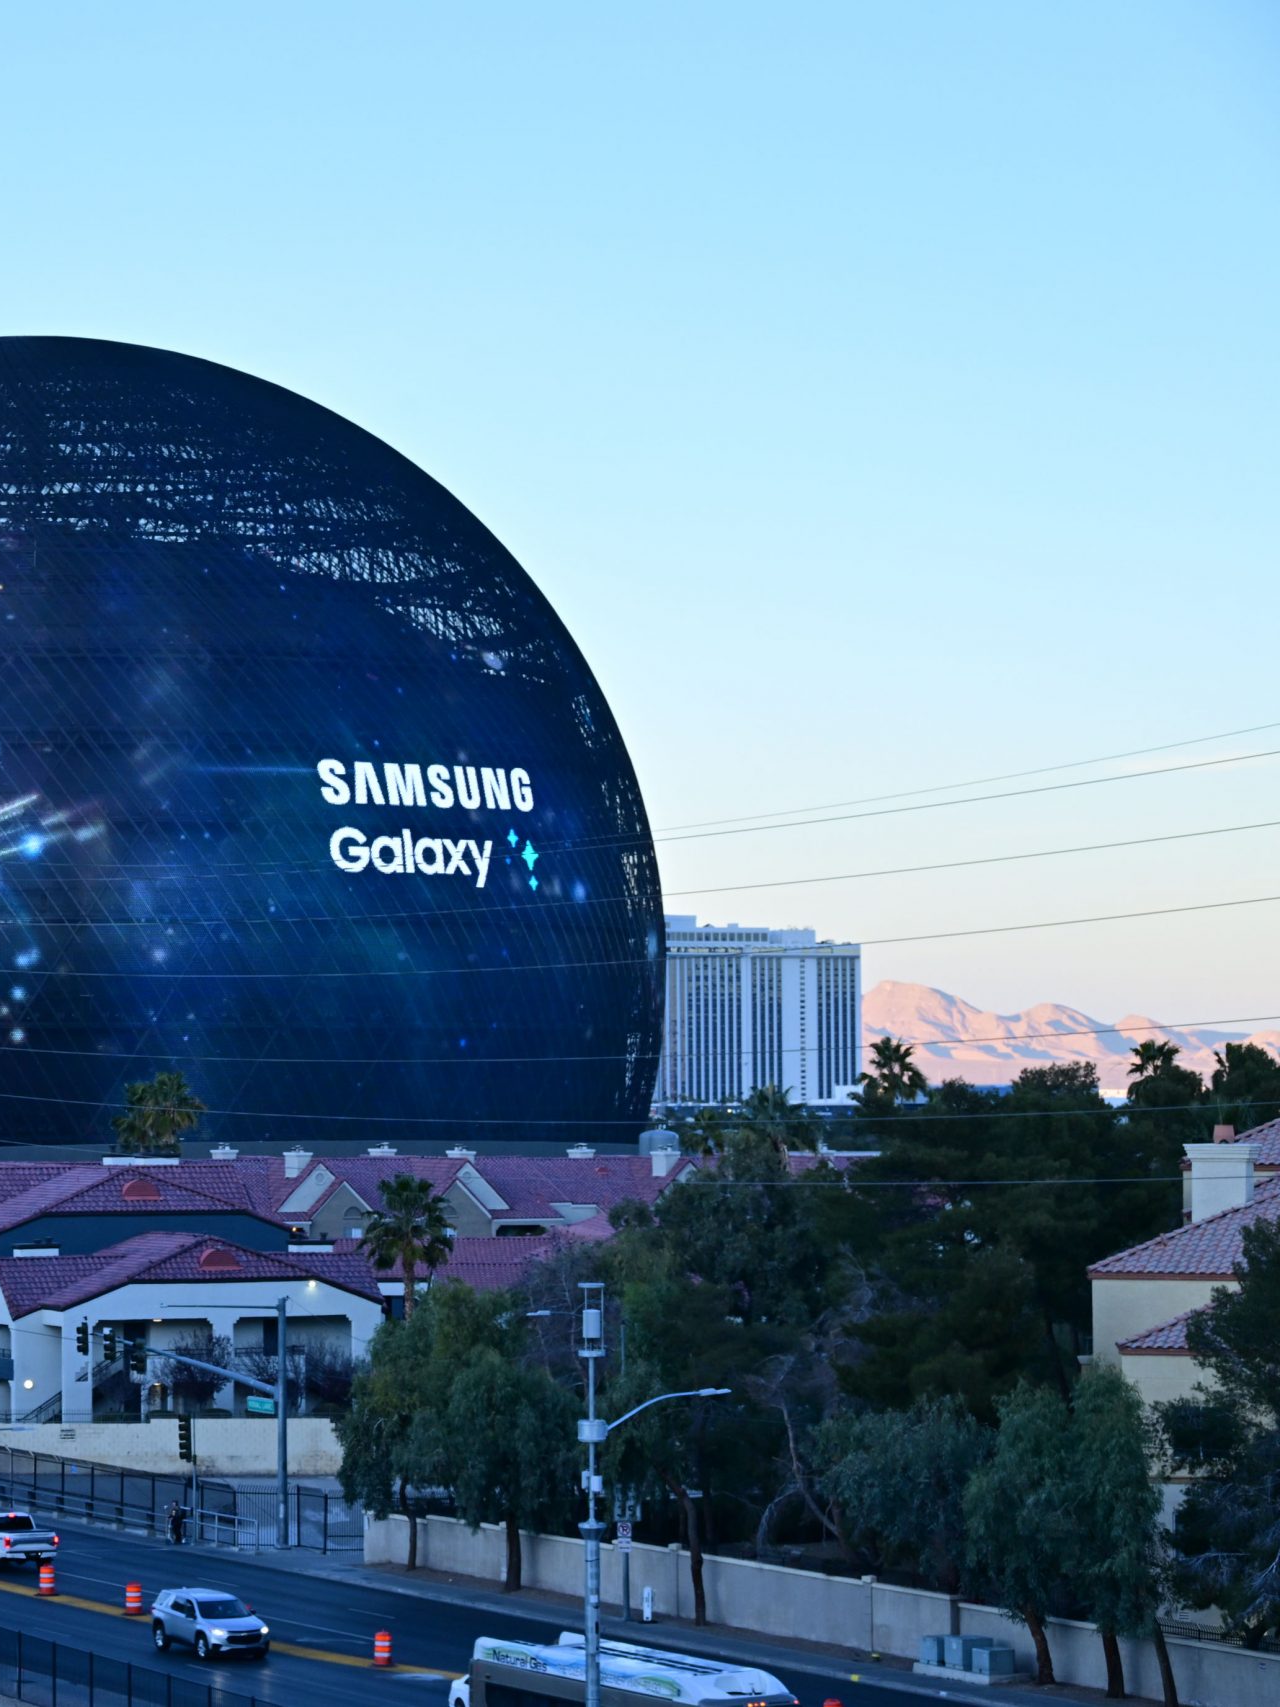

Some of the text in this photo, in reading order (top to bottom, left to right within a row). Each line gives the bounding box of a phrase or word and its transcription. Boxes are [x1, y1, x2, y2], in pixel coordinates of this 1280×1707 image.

[317, 758, 534, 812] SAMSUNG
[329, 826, 493, 888] Galaxy
[492, 1649, 528, 1669] Natural
[529, 1655, 548, 1672] Gas
